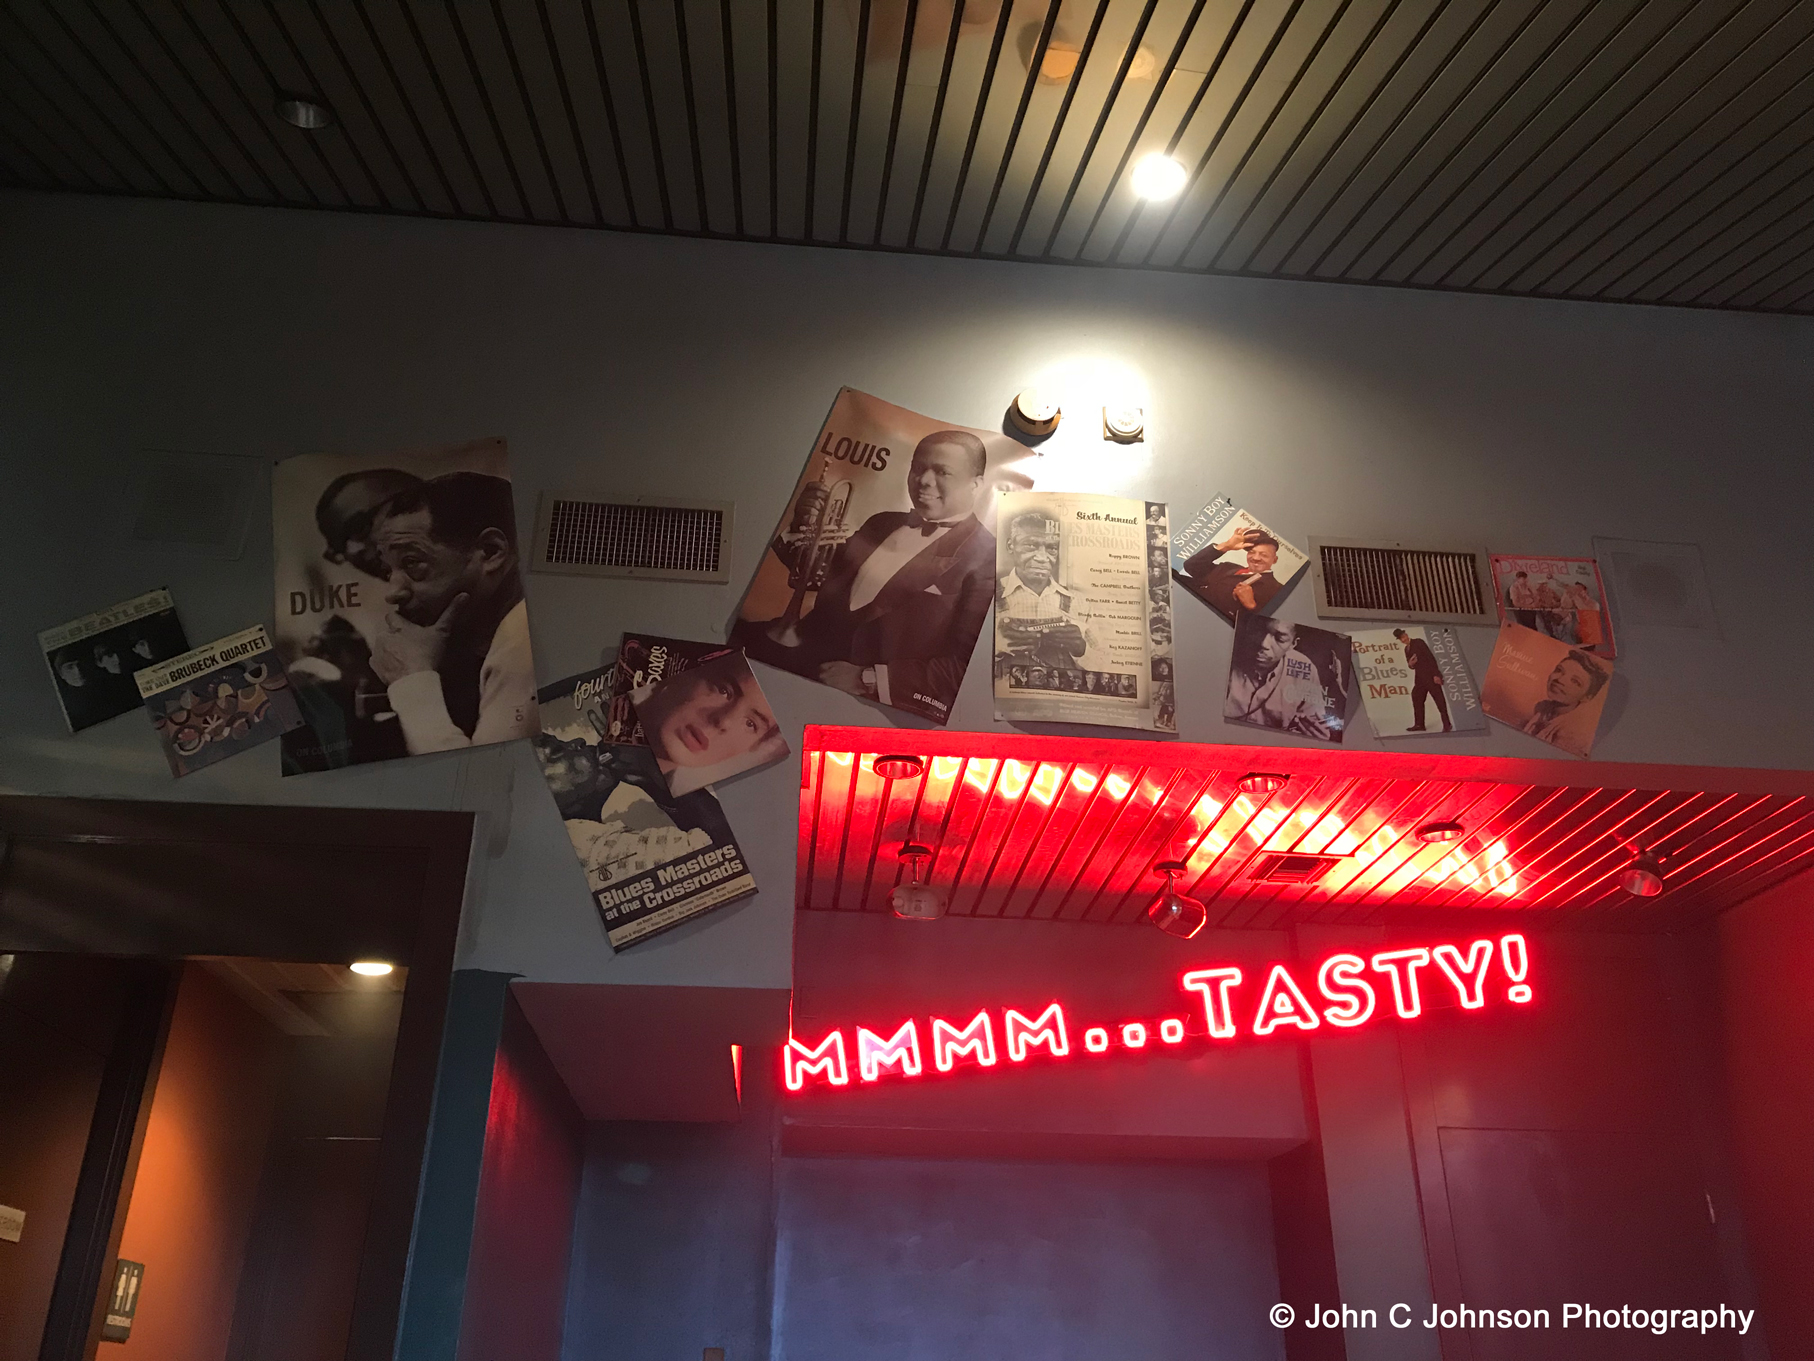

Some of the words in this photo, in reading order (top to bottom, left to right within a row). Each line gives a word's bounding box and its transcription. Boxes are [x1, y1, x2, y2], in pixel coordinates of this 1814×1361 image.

[820, 432, 890, 471] LOUIS
[1076, 511, 1102, 521] Sixth
[1104, 514, 1138, 525] Annual
[1174, 514, 1208, 547] SONNY
[1204, 496, 1226, 518] BOY
[1240, 512, 1256, 526] Keep
[1086, 524, 1140, 538] MASTERS
[1176, 504, 1236, 561] WILLIAMSON
[290, 582, 362, 616] DUKE
[1351, 640, 1400, 655] Portrait
[1430, 630, 1445, 654] BOY
[170, 654, 219, 682] BRUBECK
[219, 636, 268, 663] QUARTET
[1287, 658, 1312, 672] LUSH
[1374, 654, 1385, 664] of
[1388, 655, 1394, 663] a
[1443, 628, 1477, 712] WILLIAMSON
[1286, 668, 1311, 681] LIFE
[1360, 665, 1408, 682] Blues
[1439, 657, 1461, 702] SONNY
[573, 668, 616, 710] fourt
[1368, 683, 1410, 699] Man
[922, 695, 947, 712] COLUMBIA
[598, 877, 655, 910] Blues
[656, 844, 737, 886] Masters
[605, 908, 619, 920] at
[620, 900, 642, 914] the
[644, 859, 744, 909] Crossroads
